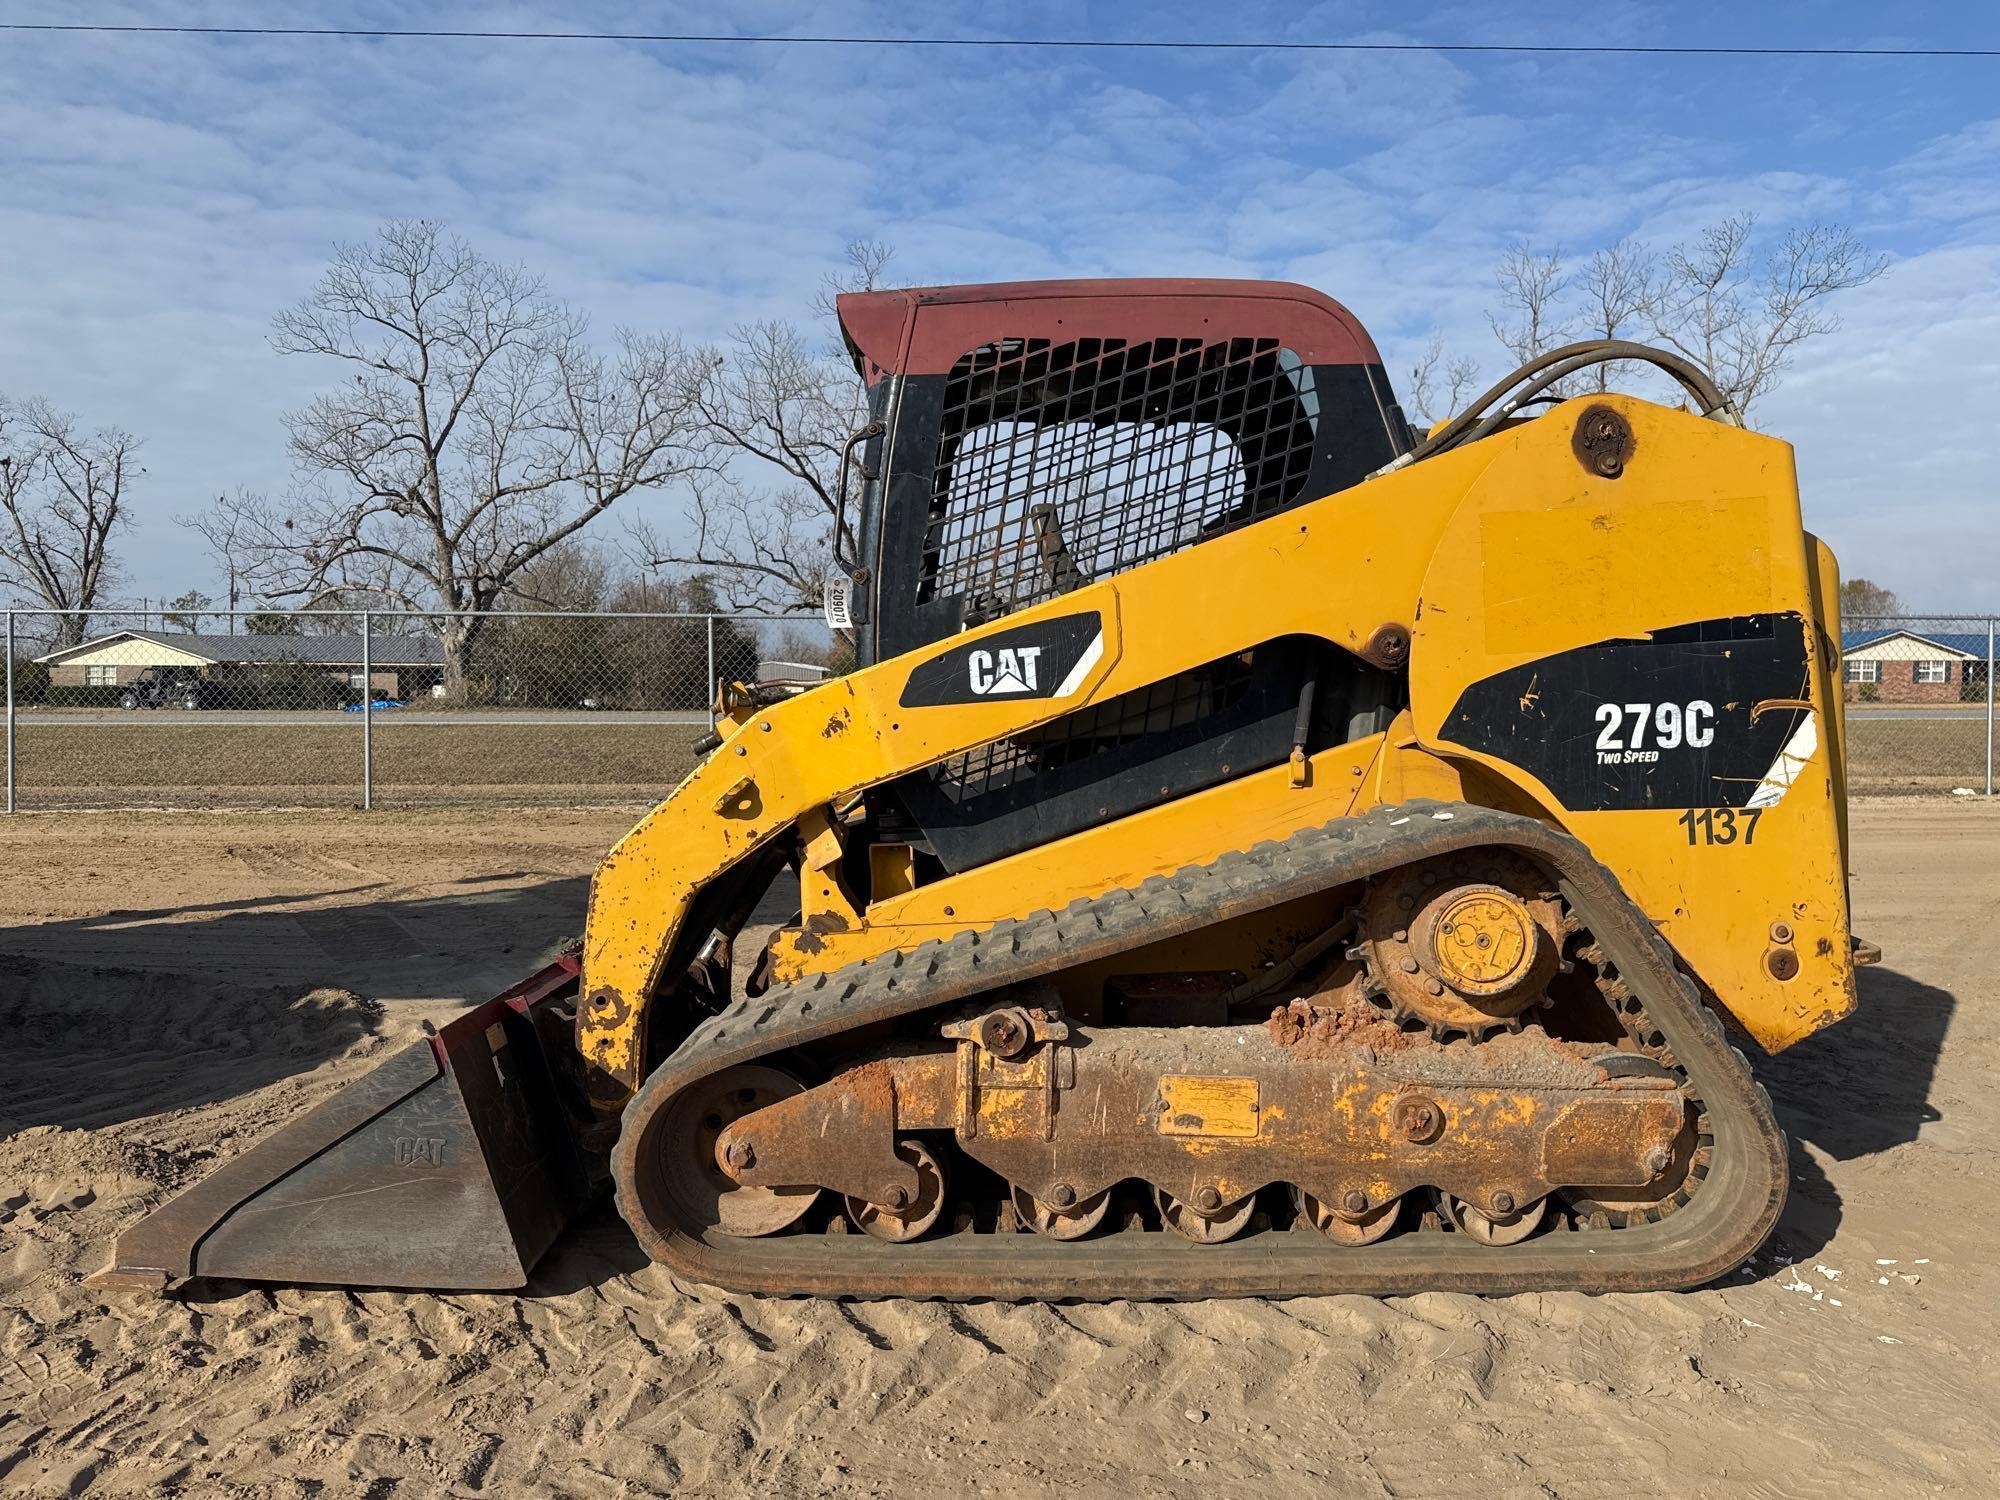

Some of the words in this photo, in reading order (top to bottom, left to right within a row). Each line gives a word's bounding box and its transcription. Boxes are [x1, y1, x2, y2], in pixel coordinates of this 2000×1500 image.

[833, 589, 847, 623] 209070
[968, 647, 1041, 695] CAT
[1595, 700, 1715, 749] 279C
[1679, 808, 1762, 846] 1137
[394, 1136, 447, 1168] CAT
